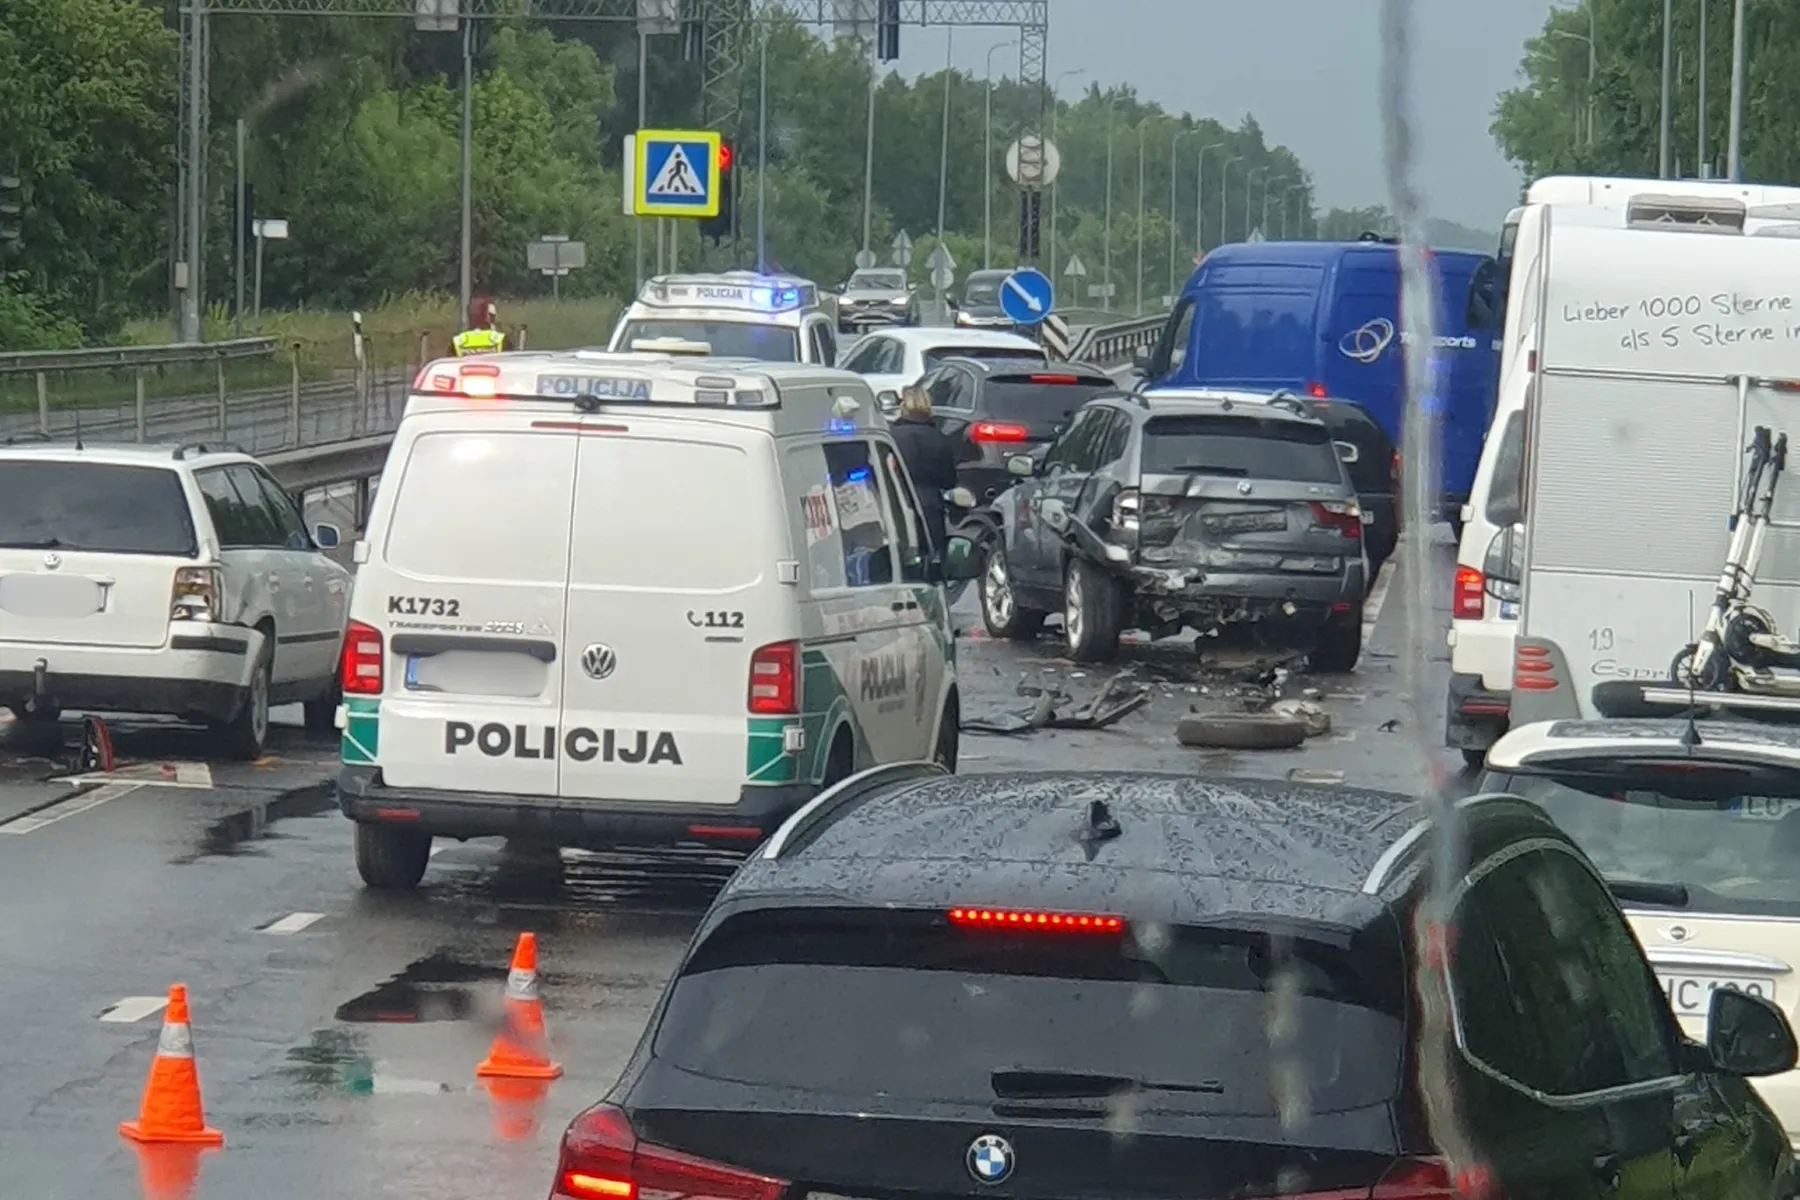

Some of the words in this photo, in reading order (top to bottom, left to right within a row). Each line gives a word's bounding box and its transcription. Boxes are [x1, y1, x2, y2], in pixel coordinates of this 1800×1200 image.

[696, 287, 744, 300] POLICIJA
[1563, 302, 1630, 322] Lieber
[1639, 296, 1701, 318] 1000
[1710, 293, 1792, 316] Sterne
[1620, 329, 1650, 351] als
[1660, 326, 1680, 348] 5
[1692, 324, 1775, 346] Sterne
[537, 377, 650, 400] POLICIJA
[388, 595, 460, 617] K1732
[704, 611, 744, 628] 112
[1590, 659, 1671, 679] Espri
[445, 720, 684, 766] POLICIJA
